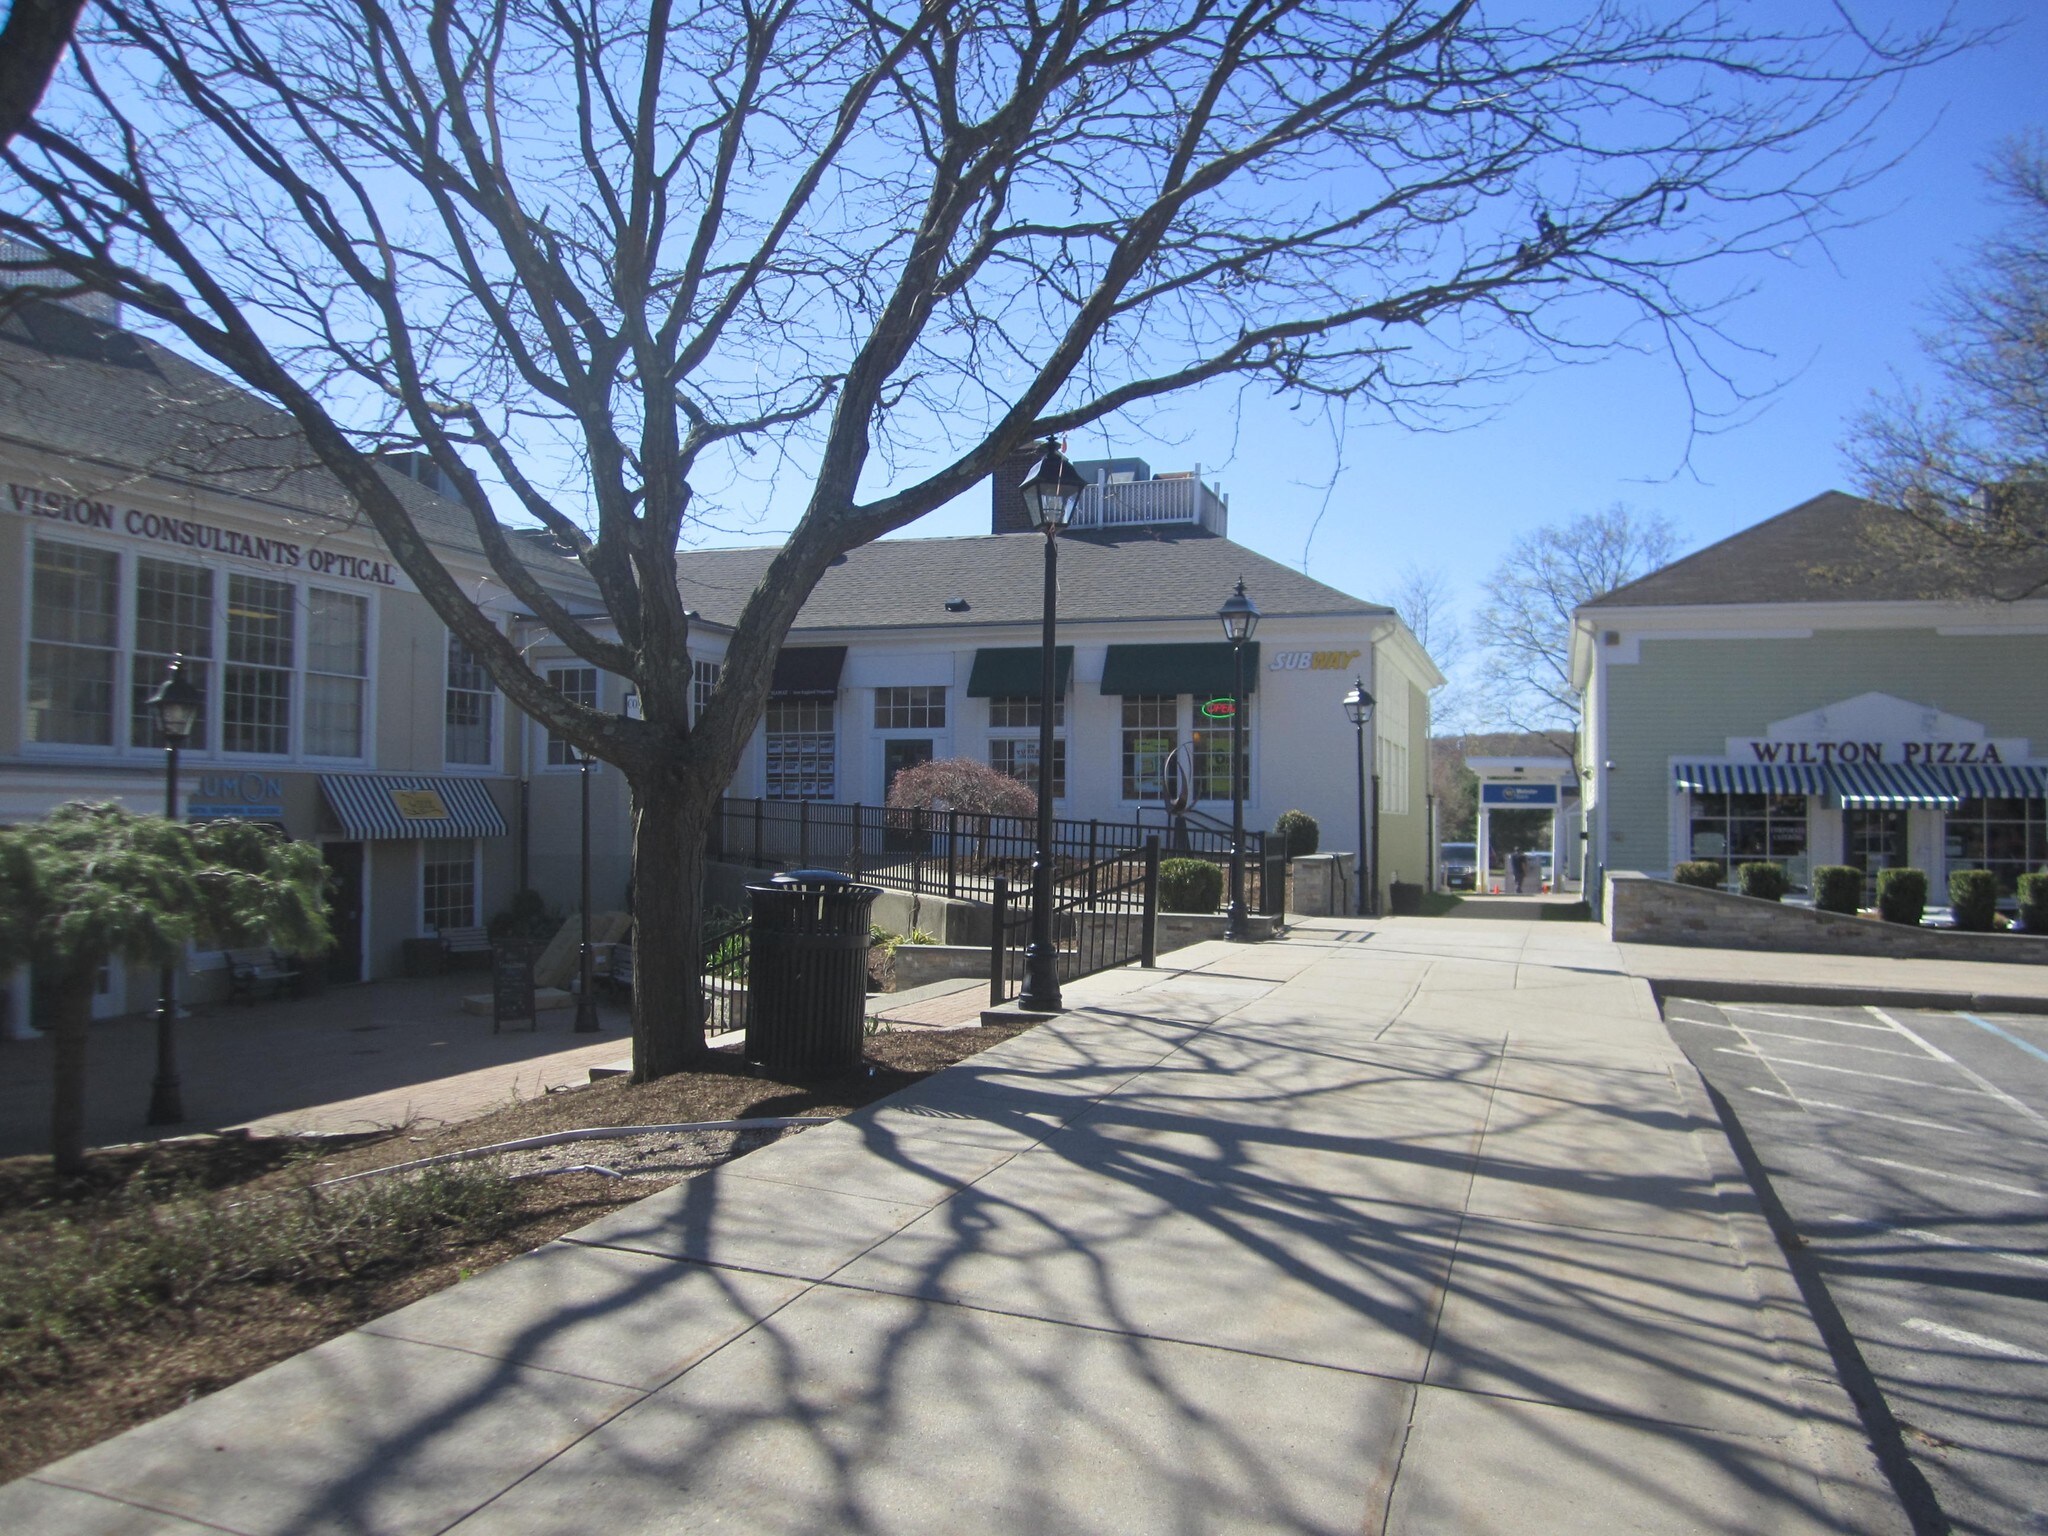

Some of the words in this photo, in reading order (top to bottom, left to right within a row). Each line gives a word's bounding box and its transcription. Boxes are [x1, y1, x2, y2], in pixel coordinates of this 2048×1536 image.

[8, 482, 114, 529] VISION
[124, 509, 300, 567] CONSULTANTS
[308, 549, 397, 586] OPTICAL
[1268, 649, 1361, 671] SUBWAY
[1750, 741, 1883, 764] WILTON
[1903, 742, 2003, 765] PIZZA
